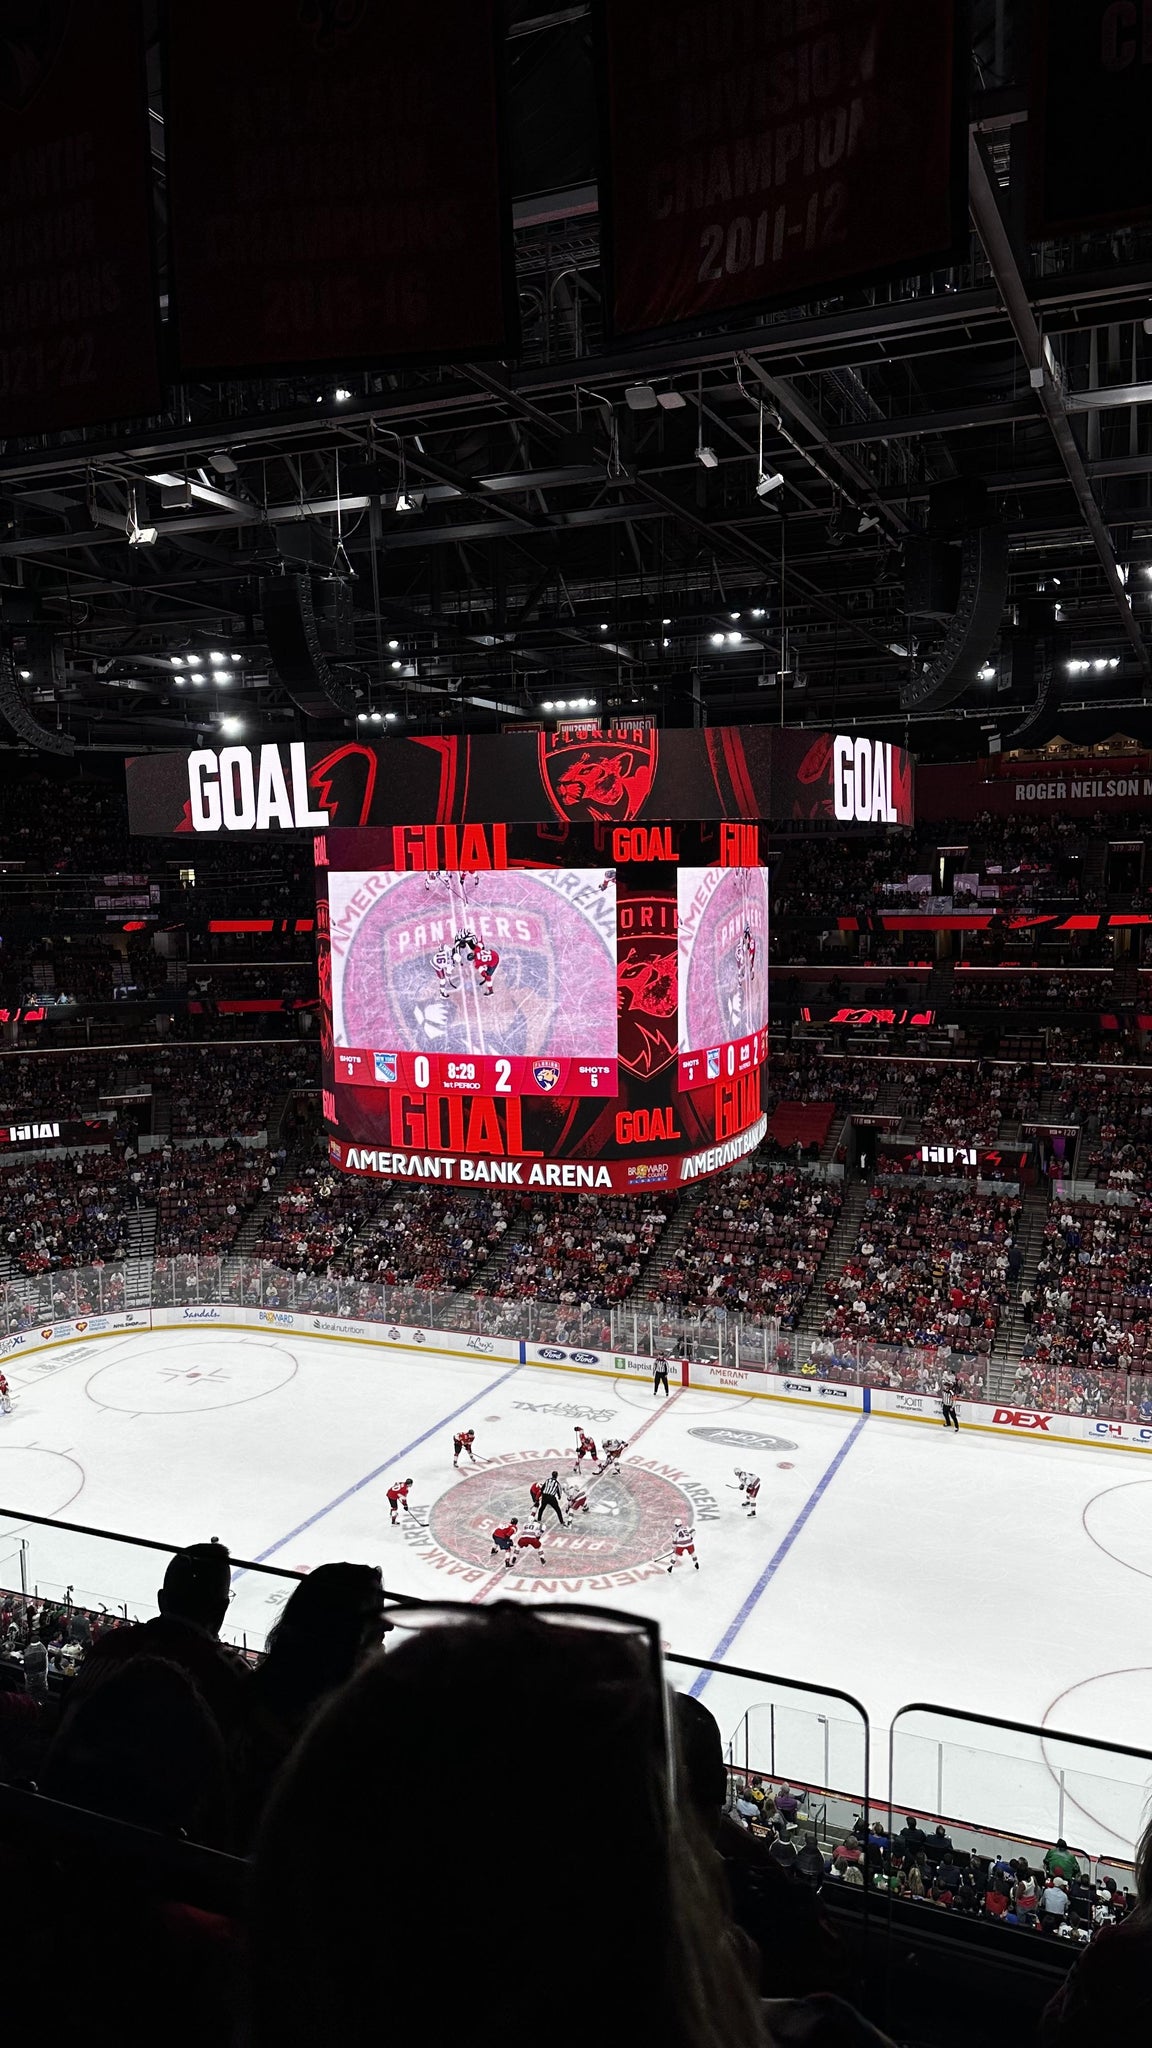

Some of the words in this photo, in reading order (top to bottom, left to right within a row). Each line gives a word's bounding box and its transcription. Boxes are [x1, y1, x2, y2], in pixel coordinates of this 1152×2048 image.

[697, 181, 850, 284] 2011-12
[187, 741, 330, 832] GOAL
[833, 735, 897, 823] GOAL
[1015, 783, 1067, 801] ROGER
[1071, 779, 1138, 799] NEILSON
[612, 826, 680, 863] GOAL
[398, 915, 532, 953] PANTHERS
[340, 1055, 361, 1063] SHOTS
[682, 1058, 699, 1068] SHOTS
[727, 1045, 735, 1076] 0
[348, 1063, 354, 1075] 3
[414, 1056, 430, 1088] 0
[448, 1062, 475, 1080] 8:29
[495, 1059, 512, 1092] 2
[579, 1065, 610, 1074] SHOTS
[688, 1067, 694, 1080] 3
[454, 1081, 481, 1090] PERIOD
[591, 1075, 598, 1087] 5
[716, 1076, 764, 1141] GOAL
[389, 1092, 544, 1157] GOAL
[615, 1107, 681, 1145] GOAL
[1025, 1127, 1037, 1135] 119
[1064, 1129, 1077, 1137] 120
[680, 1137, 742, 1181] AMERANT
[346, 1148, 456, 1180] AMERANT
[460, 1160, 524, 1185] BANK
[528, 1163, 613, 1188] ARENA
[183, 1308, 220, 1319] Sandals
[12, 1336, 26, 1348] XL
[543, 1350, 562, 1360] Ford
[574, 1353, 594, 1364] Ford
[628, 1361, 652, 1371] Baptist
[709, 1368, 749, 1380] AMERANT
[720, 1378, 738, 1387] BANK
[904, 1397, 923, 1407] JOINT
[992, 1409, 1054, 1431] DEX
[1096, 1423, 1122, 1436] CH
[712, 1430, 778, 1450] Ford
[626, 1455, 690, 1482] BANK
[682, 1480, 720, 1523] ARENA
[678, 1529, 690, 1538] 45
